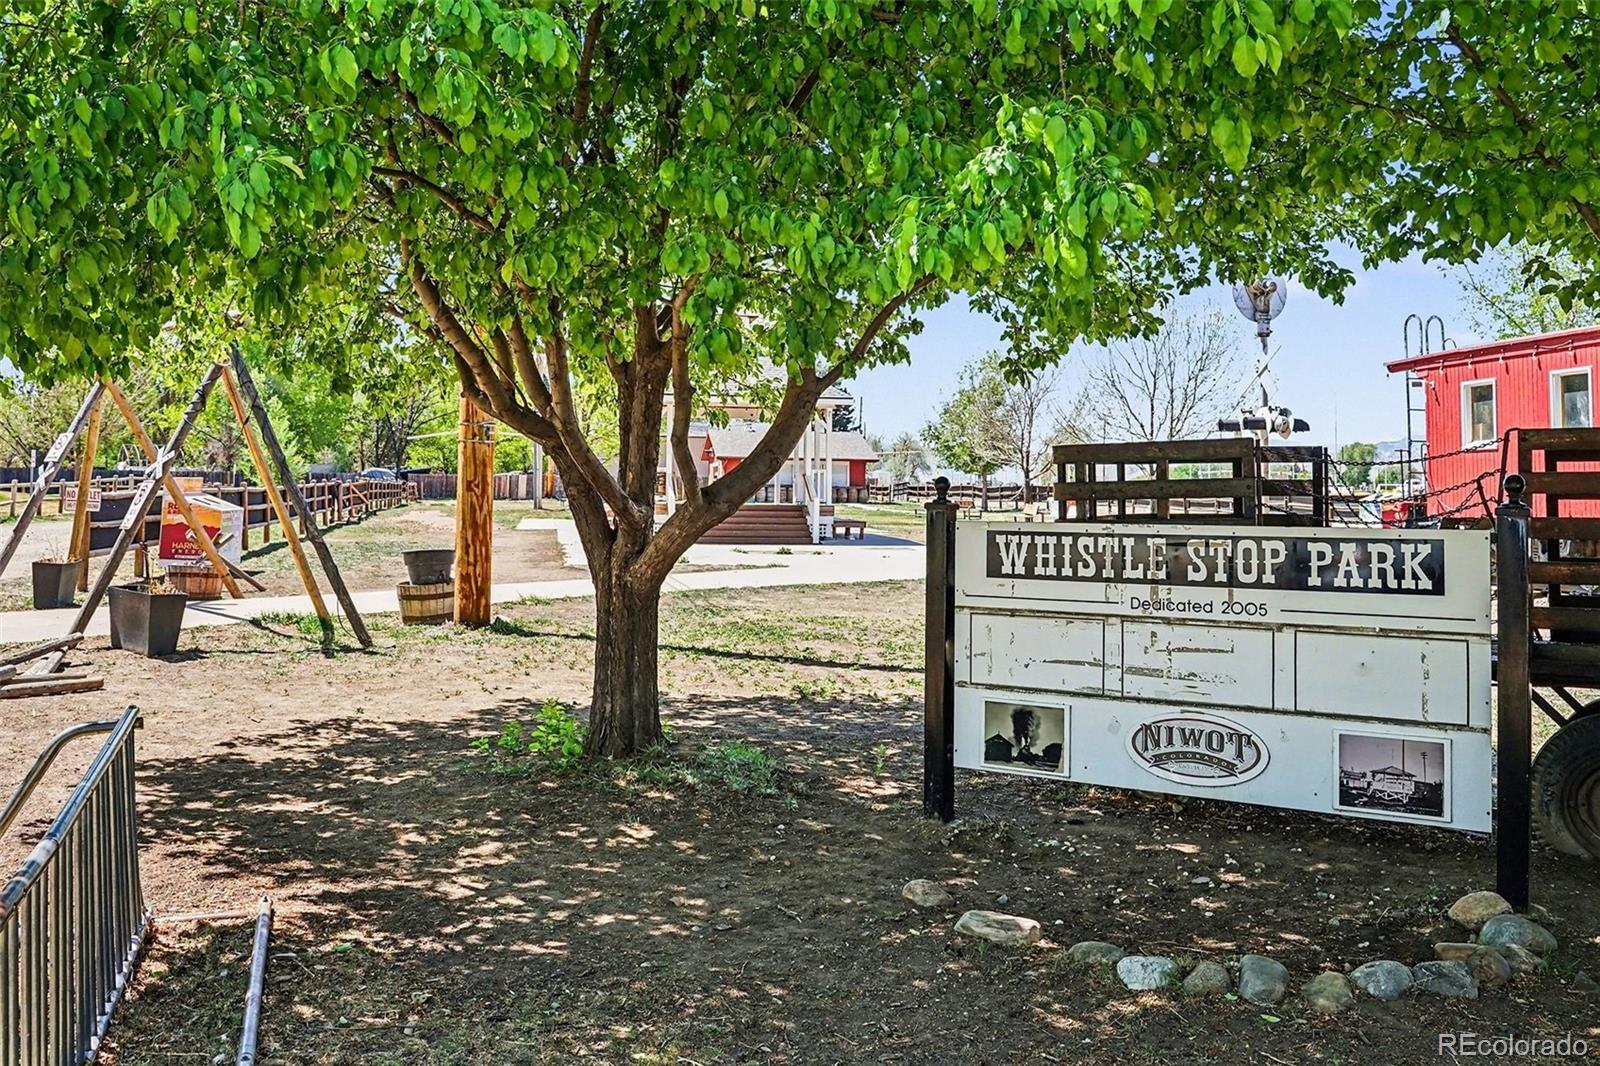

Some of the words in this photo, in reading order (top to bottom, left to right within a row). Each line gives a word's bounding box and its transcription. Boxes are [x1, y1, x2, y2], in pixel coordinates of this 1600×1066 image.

[66, 490, 76, 499] NO
[995, 534, 1167, 580] WHISTLE
[1187, 538, 1288, 584] STOP
[1307, 542, 1433, 590] PARK
[1130, 597, 1214, 614] Dedicated
[1221, 601, 1268, 617] 2005
[1140, 722, 1253, 763] NIWOT
[1161, 752, 1228, 767] COLORADO
